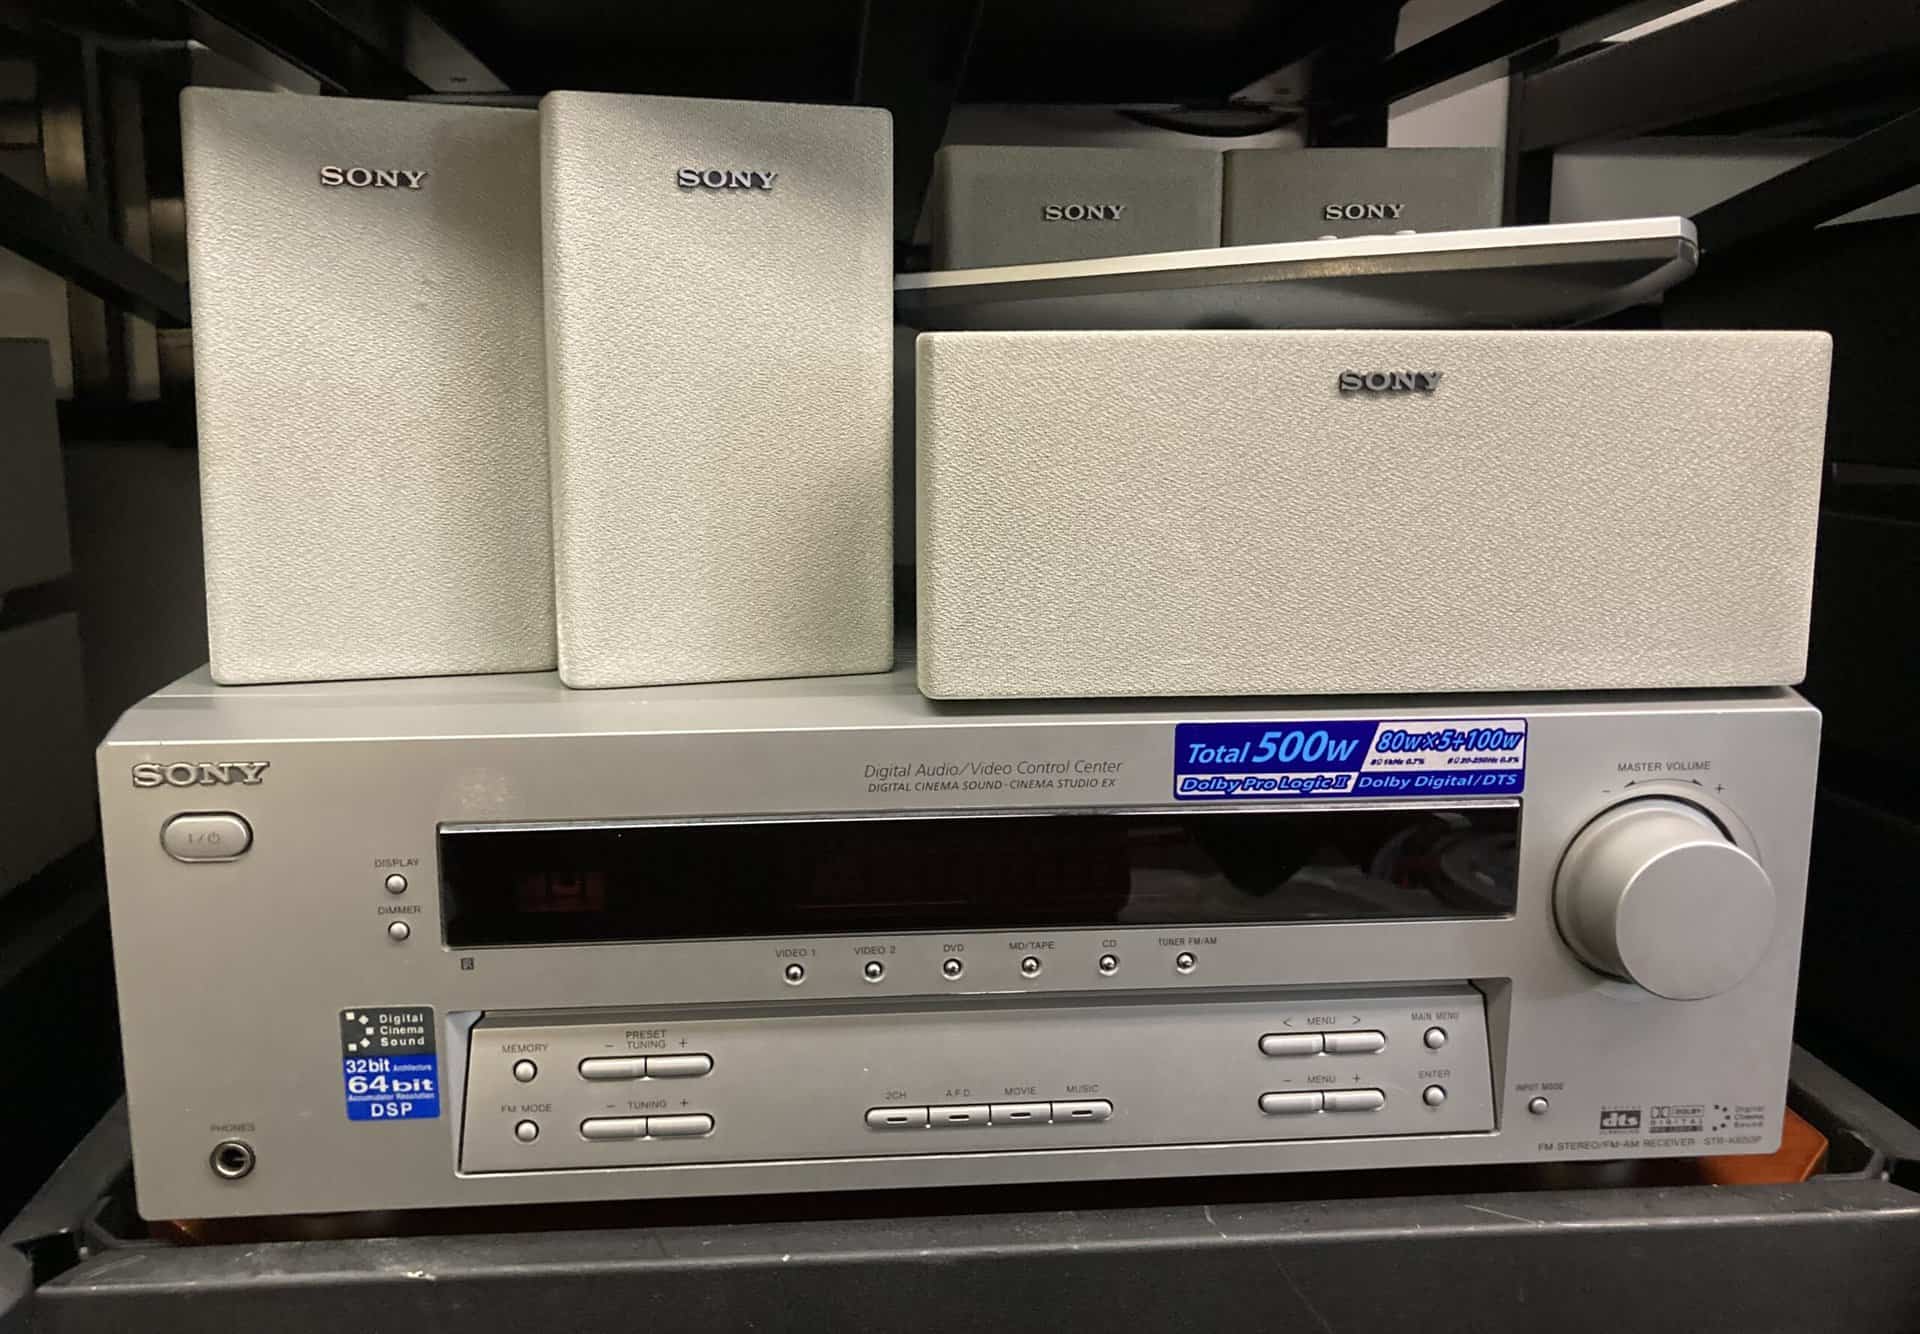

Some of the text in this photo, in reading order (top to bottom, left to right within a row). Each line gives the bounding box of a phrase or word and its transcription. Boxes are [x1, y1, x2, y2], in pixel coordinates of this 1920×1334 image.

[320, 165, 427, 190] SONY
[677, 167, 777, 191] SONY
[1044, 204, 1126, 221] SONY
[1324, 203, 1405, 220] SONY
[1339, 369, 1442, 394] SONY
[1188, 742, 1251, 764] Total
[864, 759, 1124, 780] Digital Audio/Video Control Center
[1617, 761, 1711, 772] MASTER VOLUME
[132, 762, 270, 787] SONY
[868, 782, 912, 793] DIGITAL
[914, 781, 959, 792] CINEMA
[1057, 778, 1098, 789] STUDIO
[1101, 778, 1116, 788] EX
[1181, 777, 1240, 793] Dolby
[1242, 777, 1276, 790] Pro
[1279, 776, 1333, 793] Logic
[1358, 776, 1411, 790] Dolby
[374, 858, 420, 868] DISPLAY
[377, 904, 422, 915] DIMMER
[1009, 940, 1055, 950] MD/TAPE
[1102, 939, 1118, 948] CD
[1158, 936, 1218, 947] TUNER FM/AM
[775, 948, 807, 958] VIDEO
[854, 946, 886, 956] VIDEO
[943, 943, 965, 953] DVD
[379, 1013, 424, 1025] Digital
[1307, 1016, 1336, 1025] MENU
[1411, 1012, 1459, 1021] MAIN MENU
[380, 1025, 424, 1035] Cinema
[625, 1029, 666, 1039] PRESET
[380, 1036, 425, 1047] Sound
[627, 1039, 667, 1049] TUNING
[501, 1043, 548, 1053] MEMORY
[346, 1058, 391, 1073] 32bit
[1307, 1075, 1336, 1084] MENU
[1418, 1070, 1450, 1079] ENTER
[1004, 1086, 1037, 1096] MOVIE
[1066, 1084, 1100, 1094] MUSIC
[370, 1102, 413, 1117] DSP
[501, 1103, 552, 1113] FM MODE
[627, 1100, 667, 1110] TUNING
[1601, 1111, 1640, 1128] dts
[1643, 1137, 1696, 1148] RECEIVER
